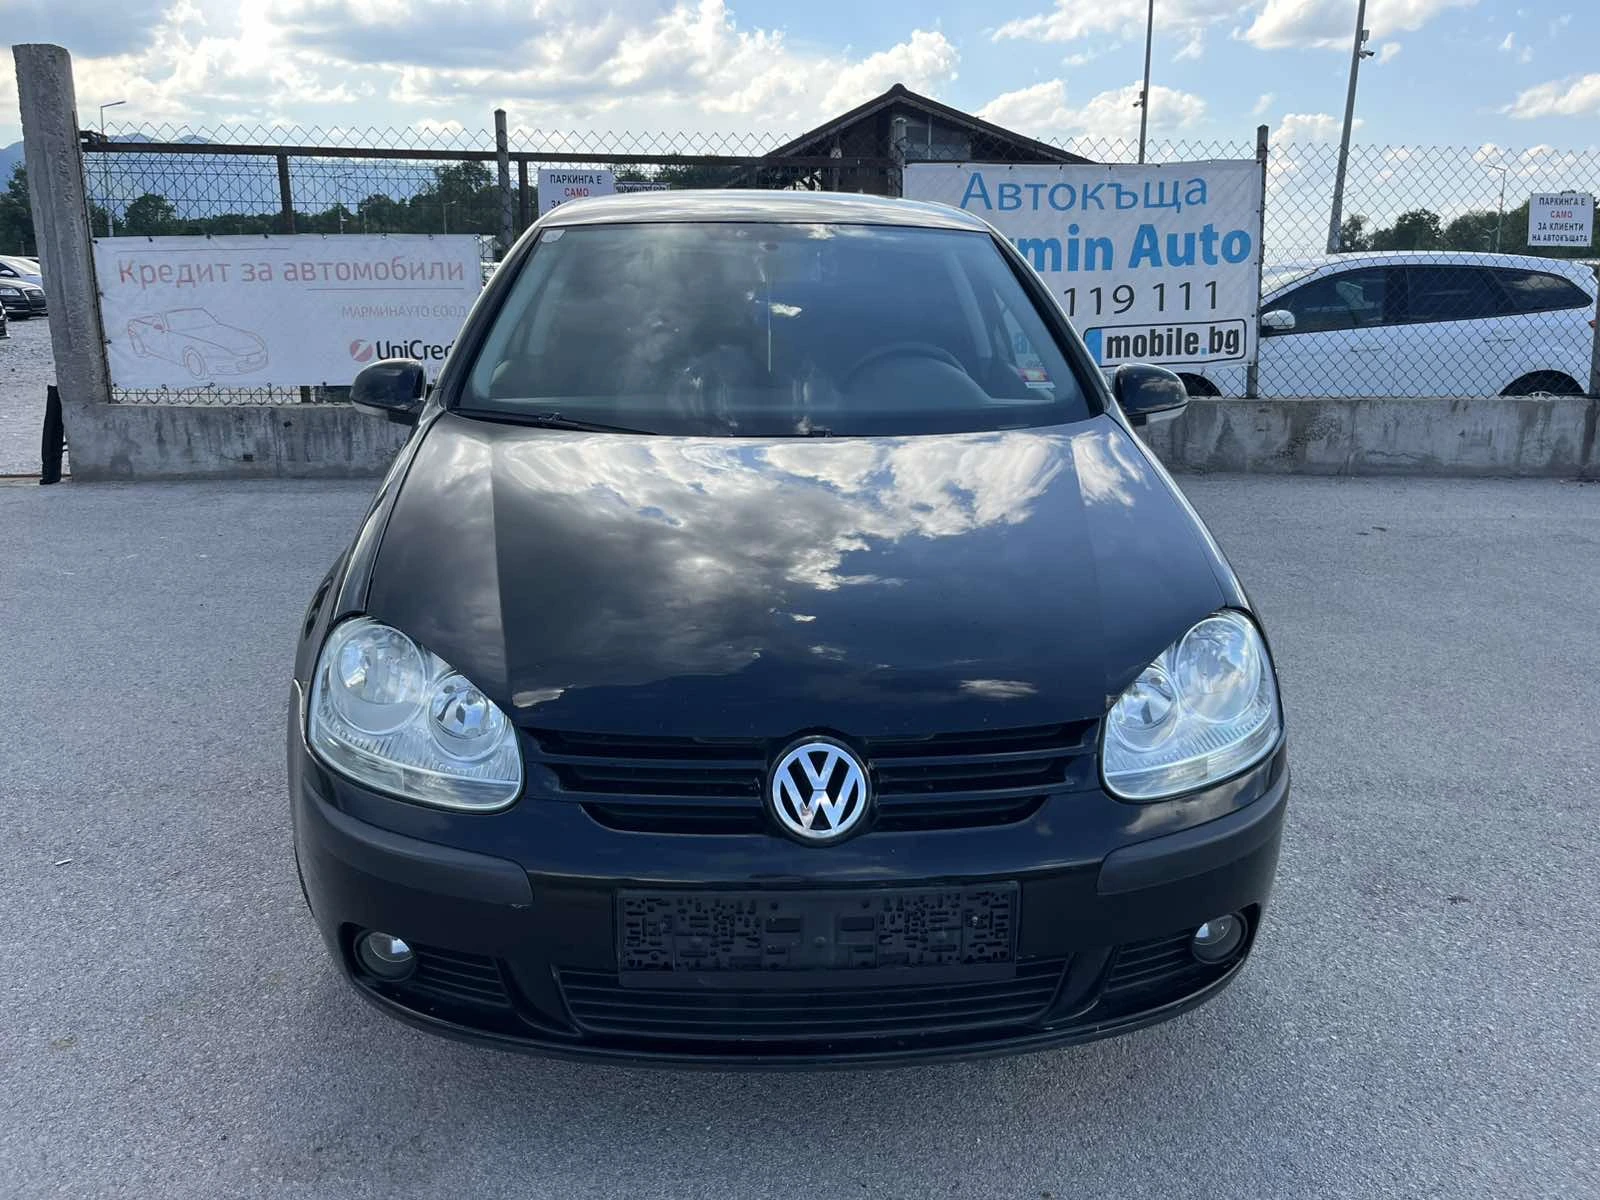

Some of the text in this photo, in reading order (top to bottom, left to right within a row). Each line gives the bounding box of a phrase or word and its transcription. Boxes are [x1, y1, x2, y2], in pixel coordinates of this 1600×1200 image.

[550, 174, 602, 184] ПАРКИНГА Е
[564, 187, 589, 197] САМО
[959, 172, 1208, 213] Автокъща
[1539, 197, 1578, 206] ПАРКИНГА
[1550, 210, 1573, 218] САМО
[1532, 233, 1540, 241] НА
[1537, 222, 1584, 231] ЗА КЛИЕНТИ
[1009, 223, 1252, 272] min Auto
[118, 255, 465, 289] Кредит за автомобили
[1063, 281, 1218, 317] 119 111
[1106, 327, 1240, 360] mobile.bg
[776, 746, 863, 836] VW
